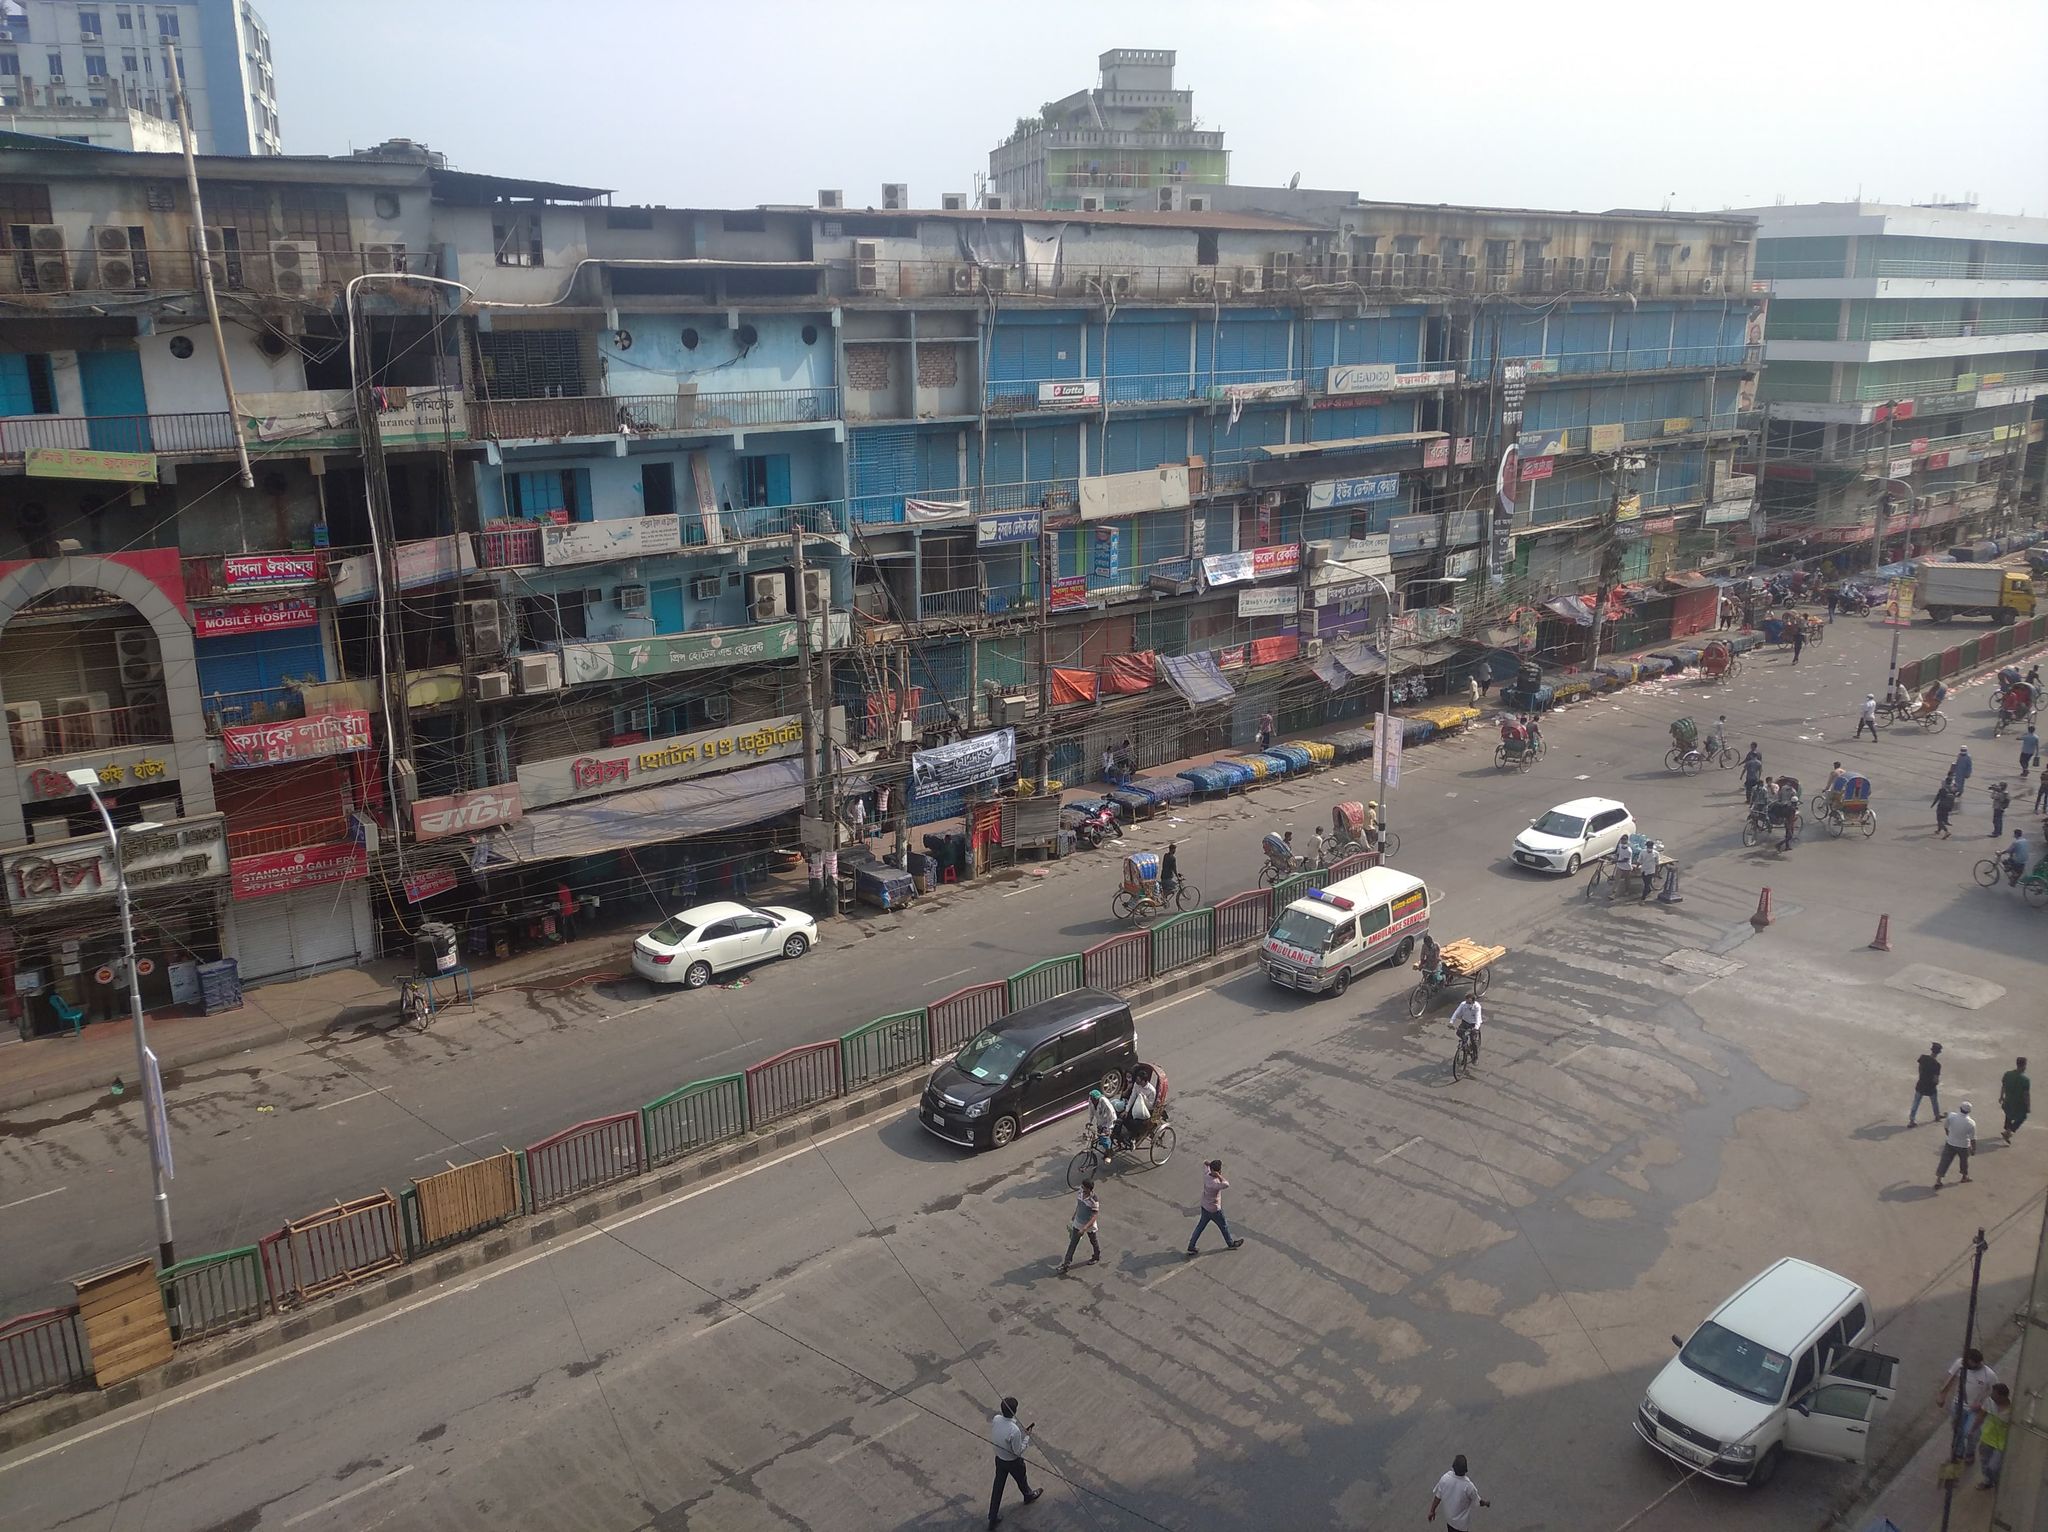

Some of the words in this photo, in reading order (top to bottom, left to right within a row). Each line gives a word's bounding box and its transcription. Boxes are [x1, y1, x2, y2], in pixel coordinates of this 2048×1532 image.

[1062, 386, 1083, 395] lotto
[228, 562, 262, 576] সাধনা
[266, 558, 314, 574] ঔষধালয়
[205, 614, 252, 629] MOBILE
[254, 609, 312, 624] HOSPITAL
[233, 726, 295, 748] ক্যাফে
[639, 743, 697, 770] হোটেল
[131, 759, 166, 779] হাউস
[420, 795, 516, 833] বাটা
[241, 865, 303, 883] STANDARD
[306, 855, 357, 871] GALLERY
[1367, 922, 1402, 945] AMBULANCE
[1402, 910, 1427, 930] SERVICE
[1266, 940, 1315, 966] AMBULANCE
